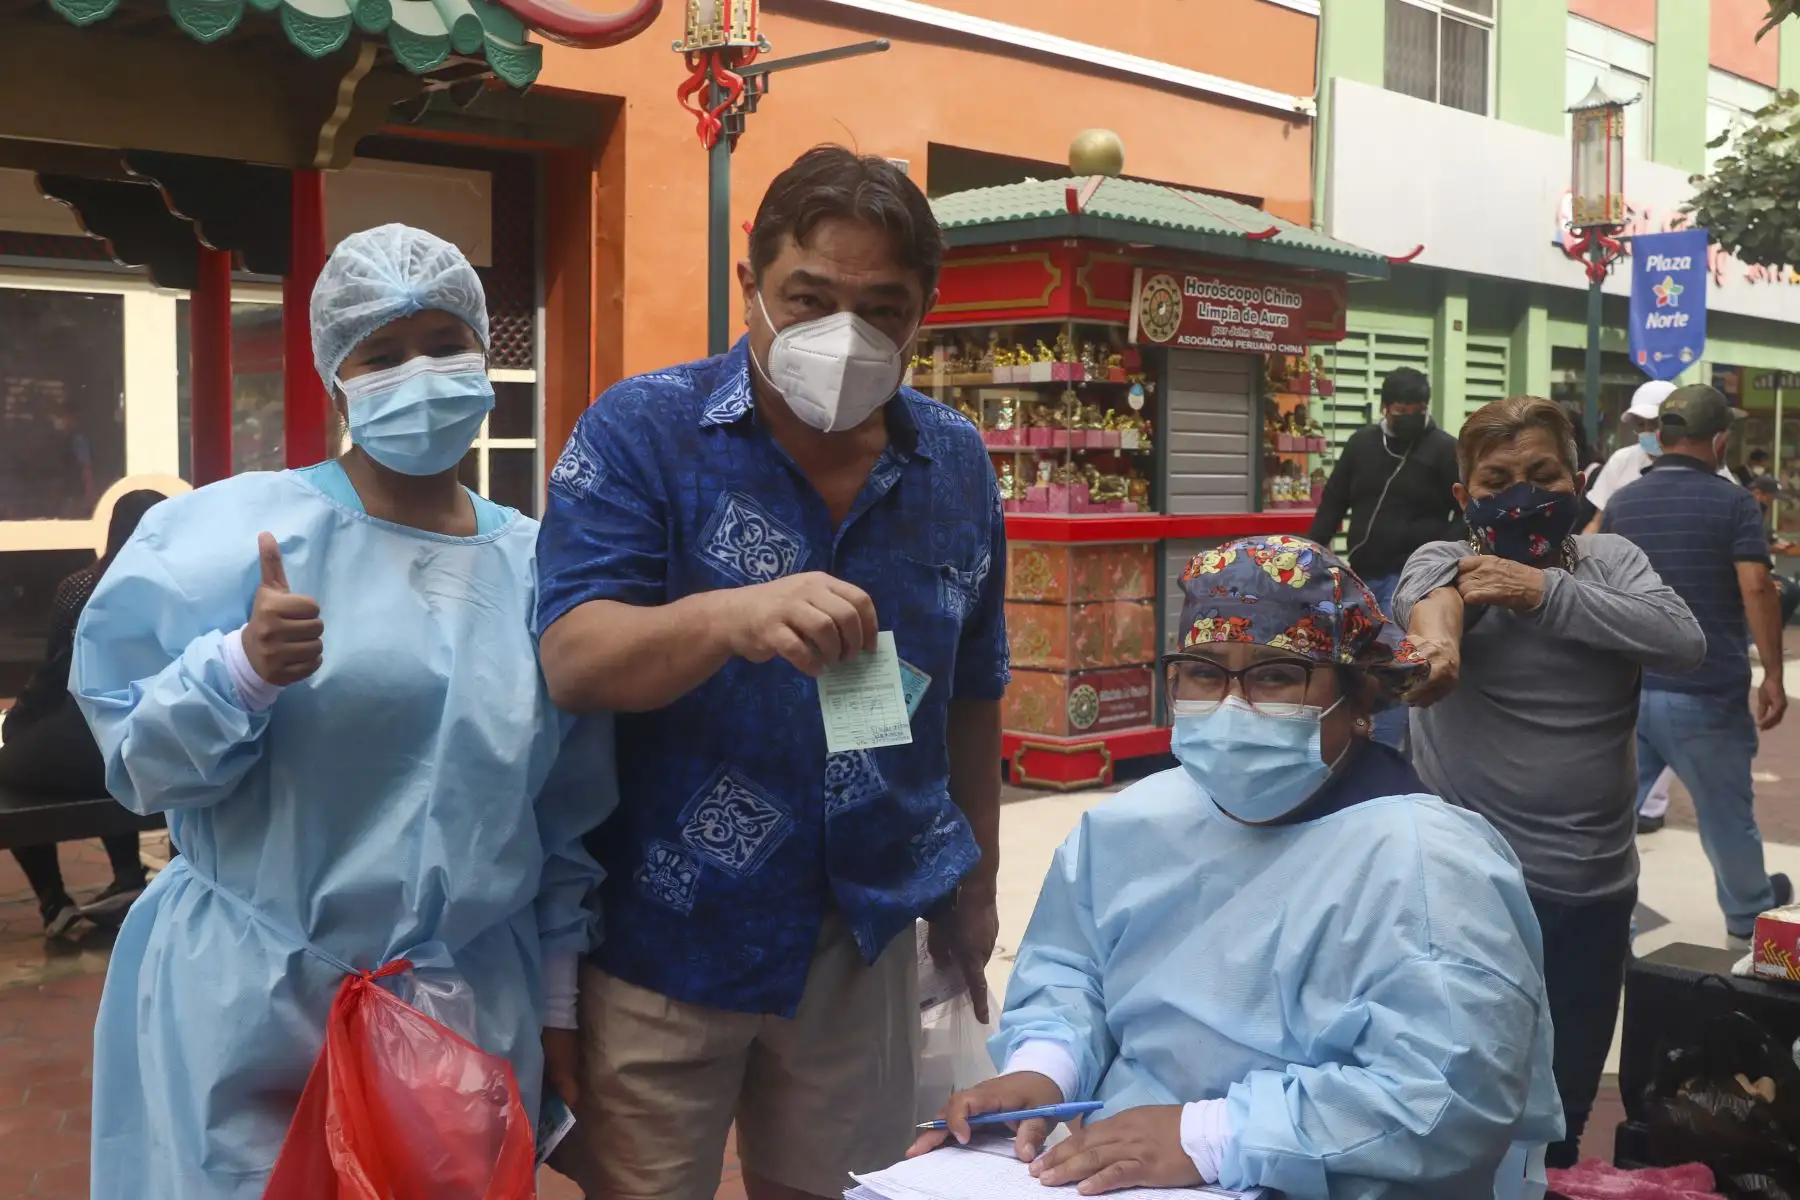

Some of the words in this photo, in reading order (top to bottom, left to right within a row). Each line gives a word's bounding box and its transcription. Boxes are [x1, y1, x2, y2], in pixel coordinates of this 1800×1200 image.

[1646, 254, 1692, 273] Plaza
[1184, 276, 1261, 305] Horóscopo
[1264, 286, 1302, 308] Chino
[1198, 302, 1240, 324] Limpia
[1242, 307, 1258, 324] de
[1259, 309, 1288, 328] Aura
[1645, 310, 1690, 330] Norte
[1178, 335, 1233, 348] ASOCIACIÓN
[1235, 340, 1277, 352] PERUANO
[1278, 343, 1304, 354] CHINA
